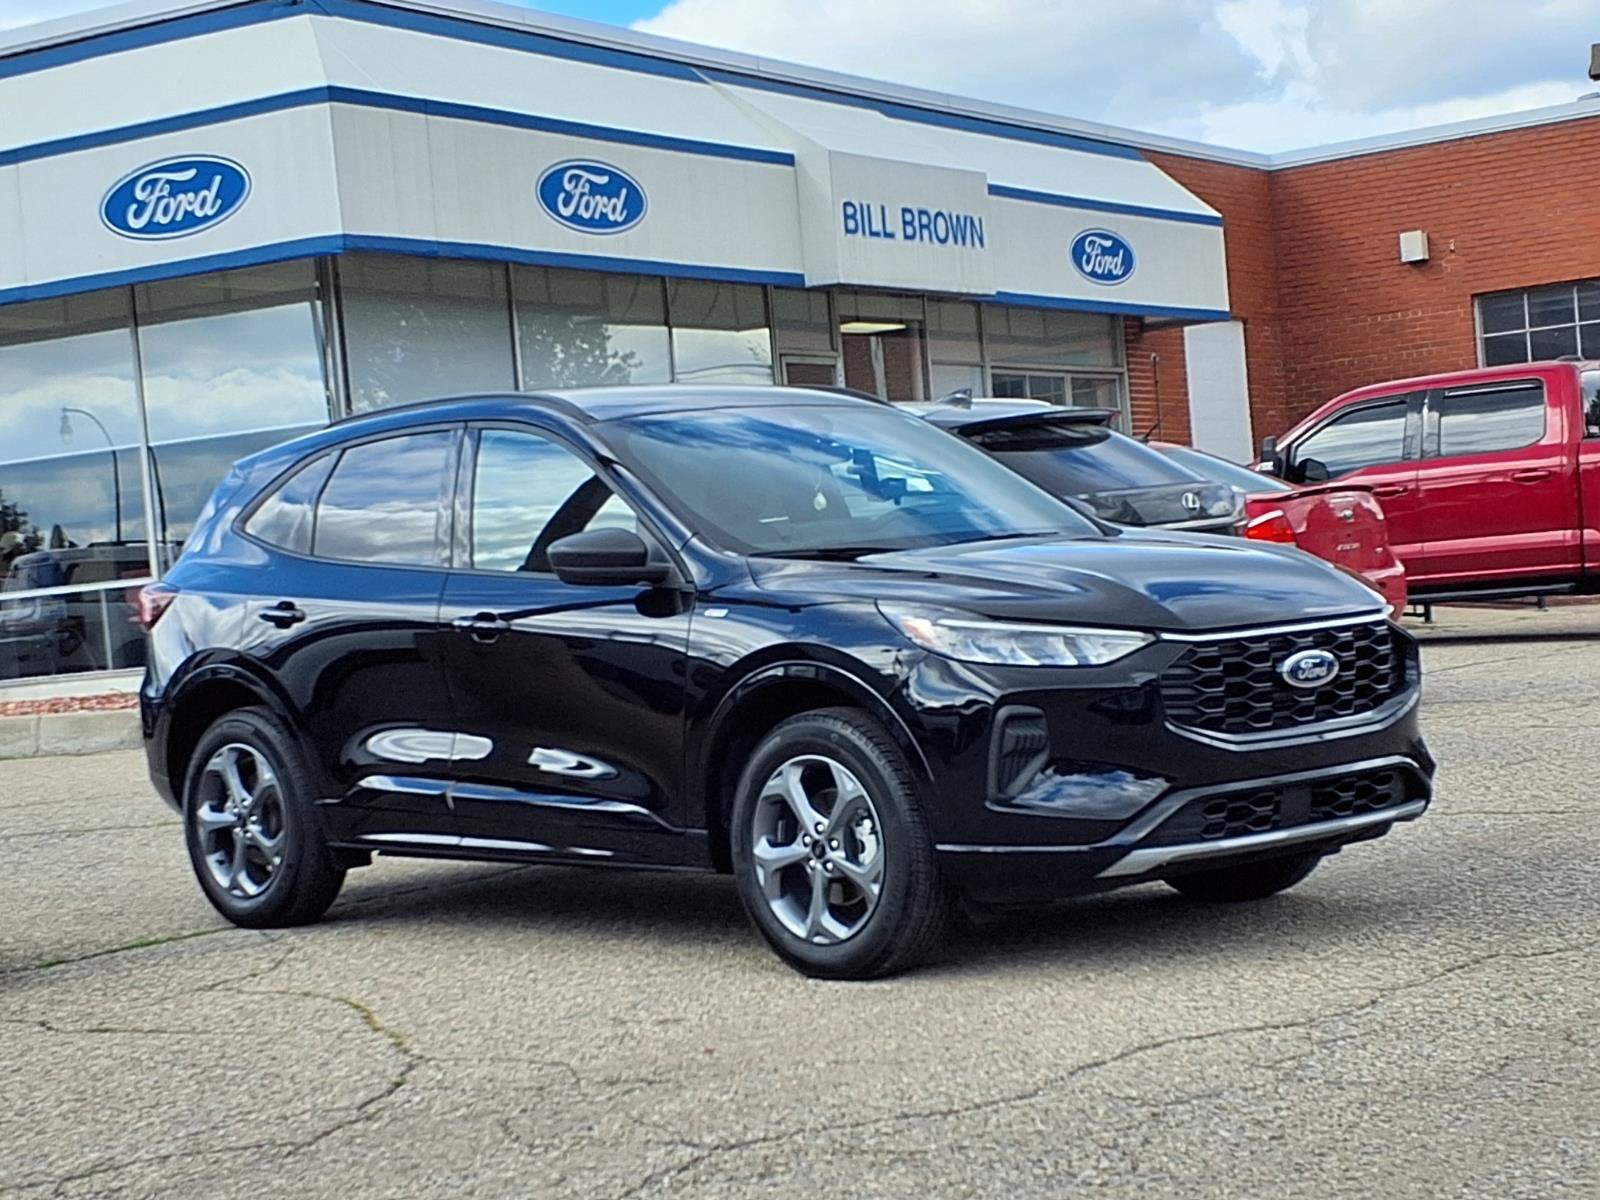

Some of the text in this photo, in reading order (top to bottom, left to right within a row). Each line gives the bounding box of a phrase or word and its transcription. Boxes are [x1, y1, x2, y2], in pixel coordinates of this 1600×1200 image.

[126, 167, 222, 229] Ford
[557, 168, 627, 222] Ford
[842, 200, 985, 248] BILL BROWN
[1082, 236, 1125, 275] Ford
[1297, 658, 1329, 679] Ford
